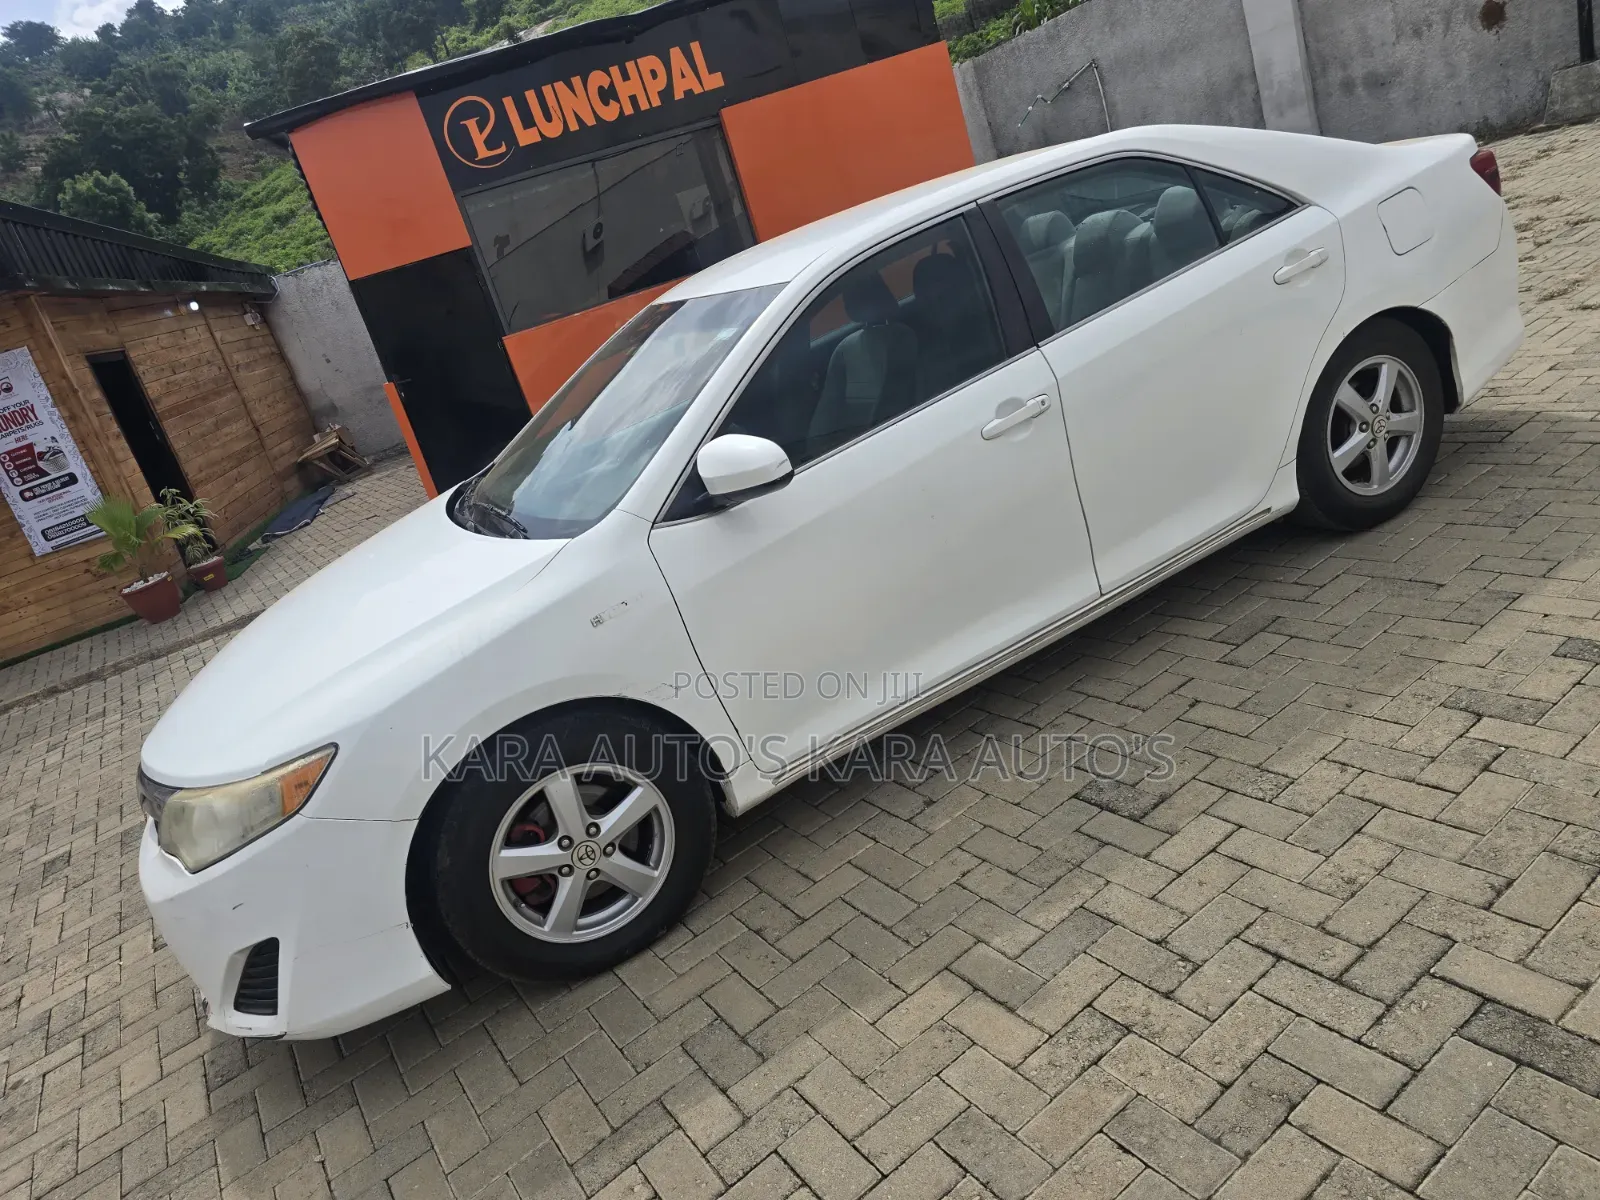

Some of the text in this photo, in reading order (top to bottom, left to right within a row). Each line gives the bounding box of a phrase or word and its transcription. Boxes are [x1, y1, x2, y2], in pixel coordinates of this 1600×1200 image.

[502, 41, 725, 147] LUNCHPAL
[11, 399, 30, 410] YOUR
[0, 403, 39, 433] UNDRY
[0, 420, 44, 440] ARPETS/RUGS
